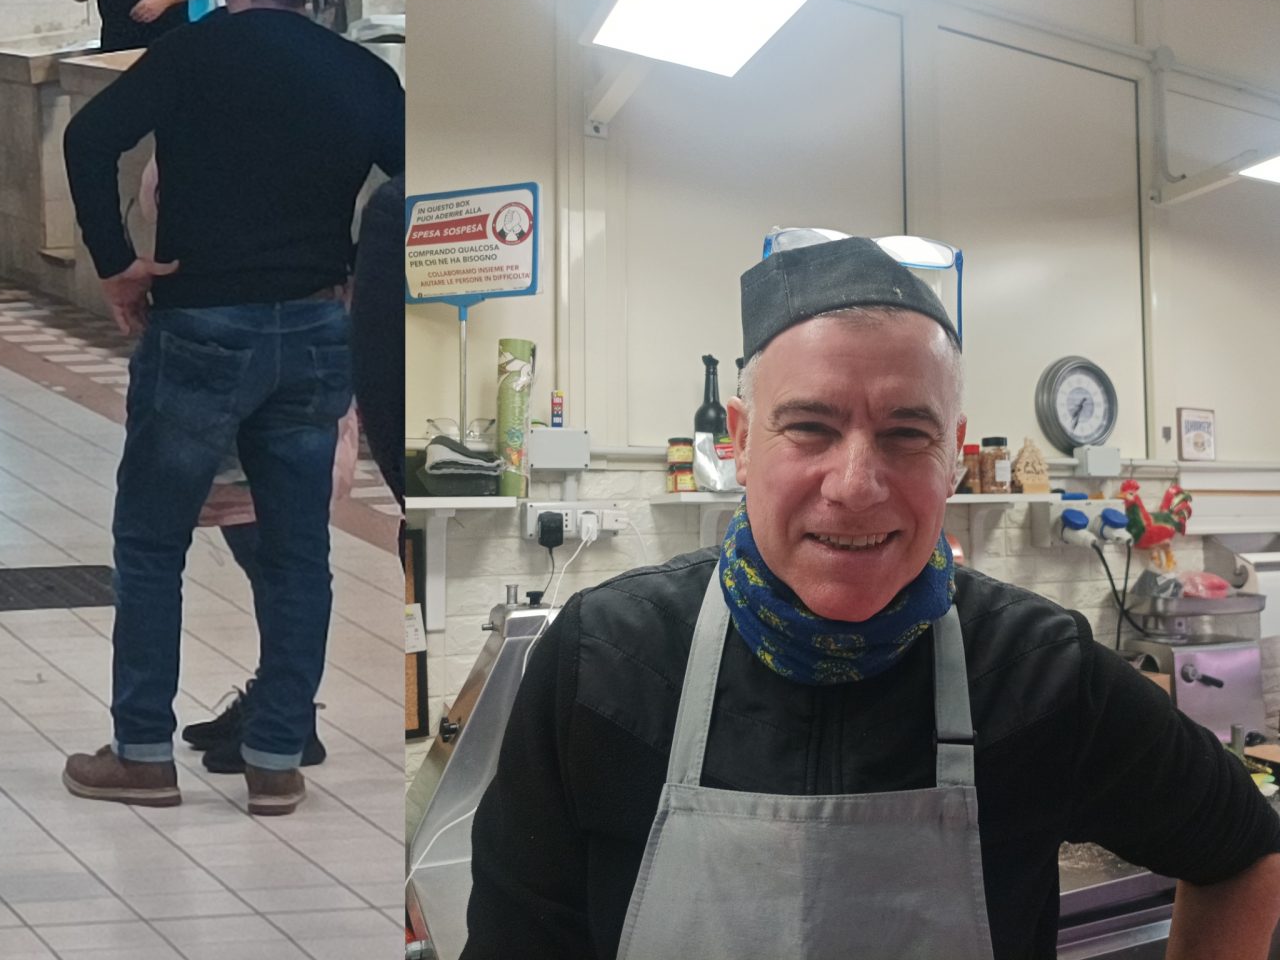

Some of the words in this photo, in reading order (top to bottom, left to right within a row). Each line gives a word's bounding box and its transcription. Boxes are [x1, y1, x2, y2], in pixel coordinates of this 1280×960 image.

[417, 207, 427, 215] IN
[426, 203, 454, 213] QUESTO
[455, 200, 470, 208] BOX
[434, 210, 463, 220] ADERIRE
[464, 207, 482, 215] ALLA
[411, 230, 441, 239] SPESA
[443, 223, 483, 236] SOSPESA
[408, 248, 456, 258] COMPRANDO
[457, 244, 500, 253] QUALCOSA
[409, 259, 424, 268] PER
[424, 258, 437, 266] CHI
[438, 257, 449, 265] NE
[450, 256, 461, 264] HA
[462, 254, 498, 263] BISOGNO
[427, 269, 476, 278] COLLABORIAMO
[478, 266, 505, 274] INSIEME
[420, 279, 446, 287] AIUTARE
[455, 276, 483, 284] PERSONE
